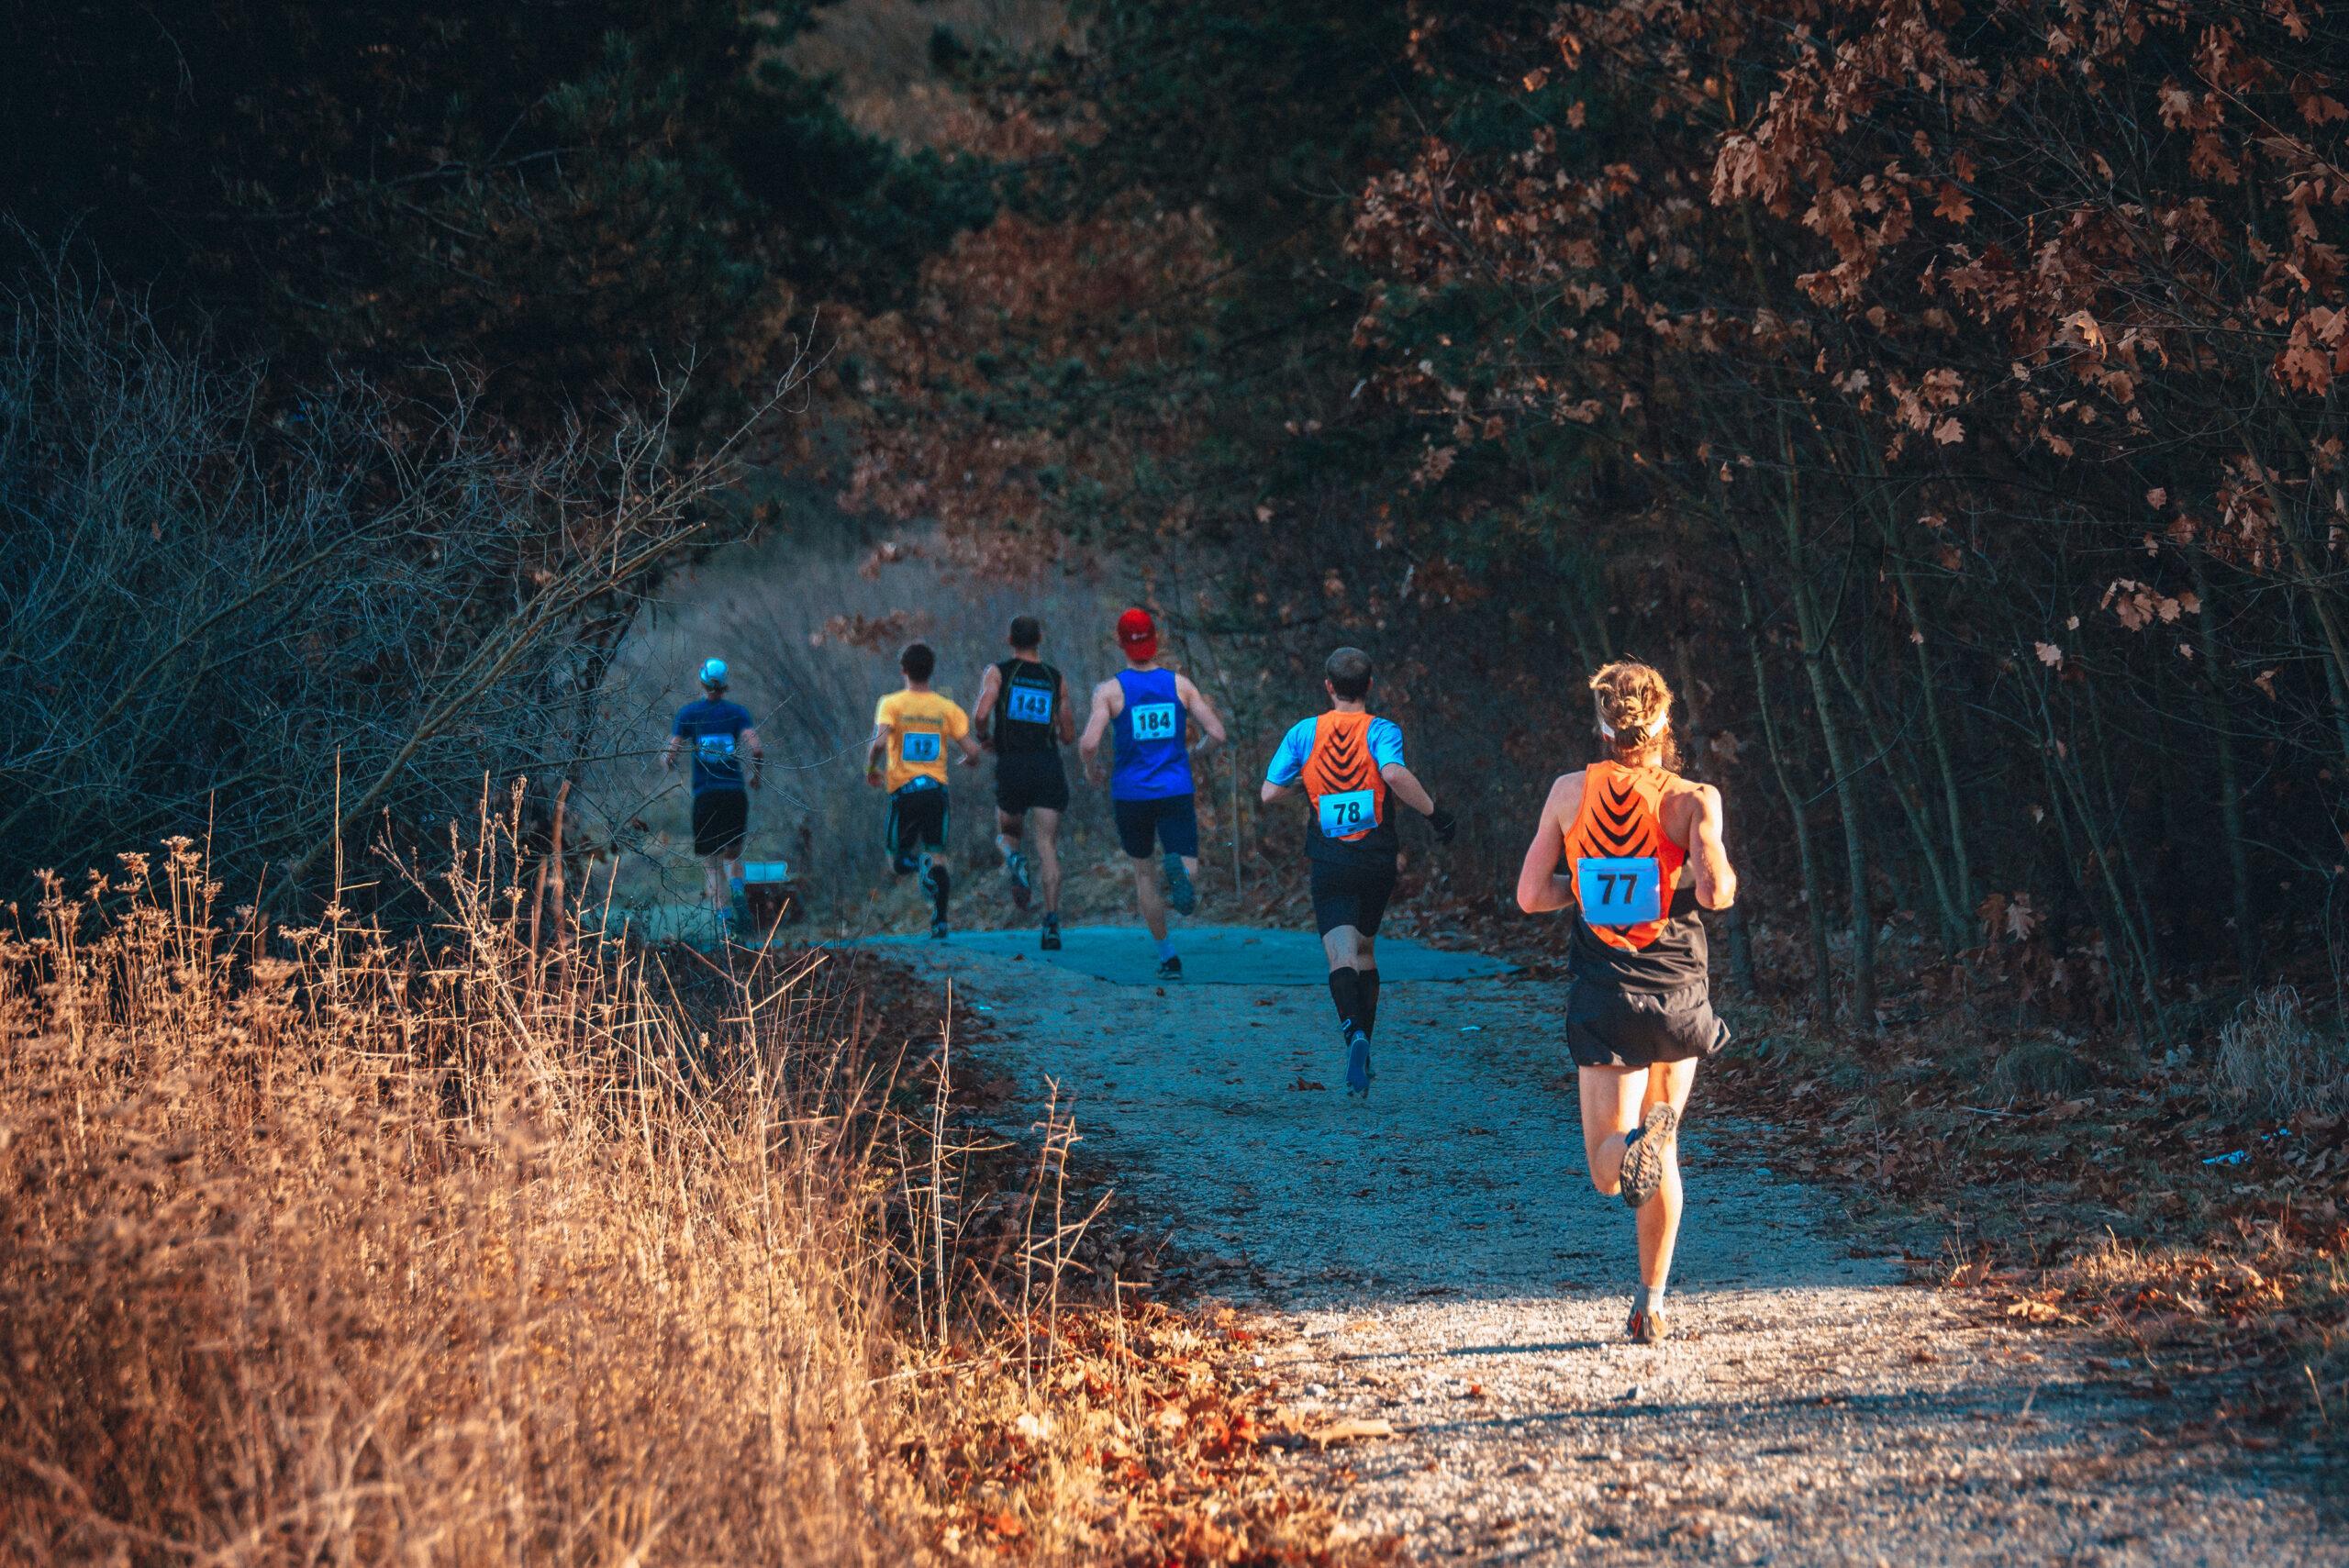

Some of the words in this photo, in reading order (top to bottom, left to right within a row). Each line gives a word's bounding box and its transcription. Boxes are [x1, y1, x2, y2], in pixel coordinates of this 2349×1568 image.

[1017, 695, 1047, 715] 143
[1139, 710, 1171, 731] 184
[1333, 801, 1361, 825] 78
[1598, 873, 1638, 905] 77
